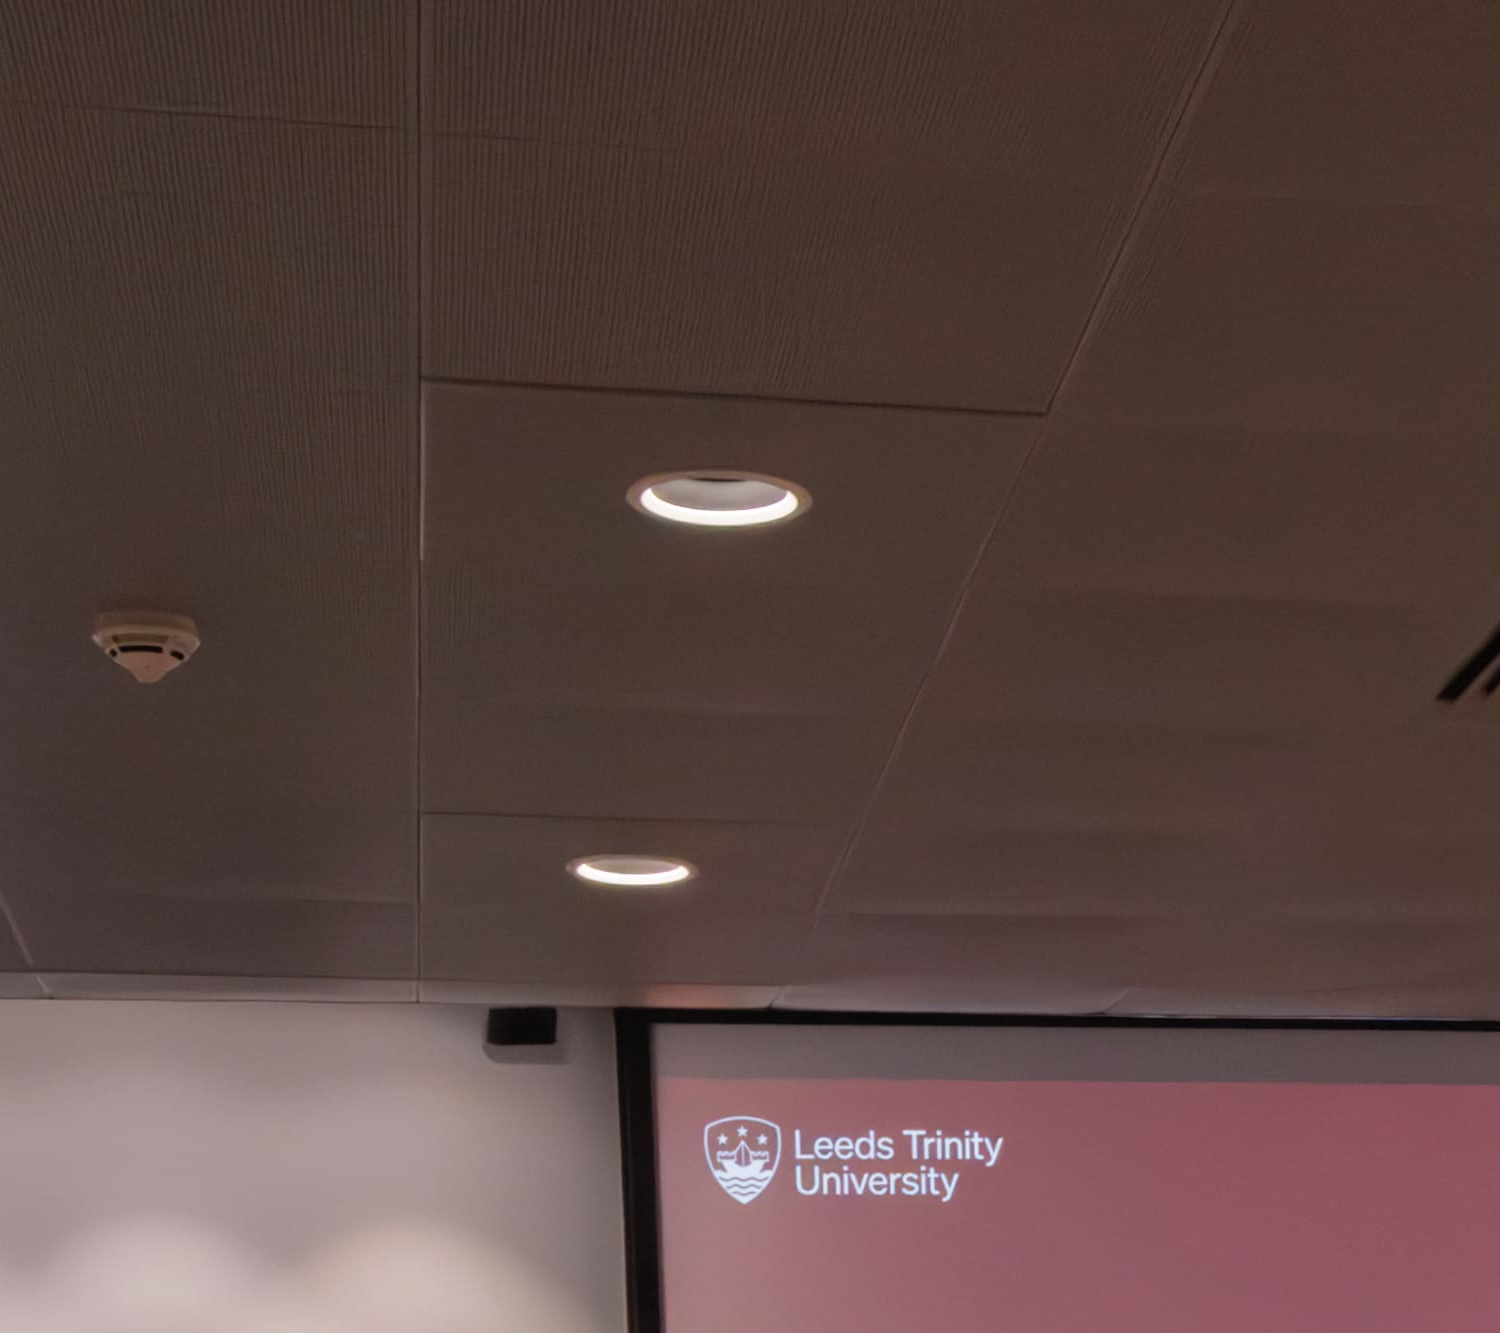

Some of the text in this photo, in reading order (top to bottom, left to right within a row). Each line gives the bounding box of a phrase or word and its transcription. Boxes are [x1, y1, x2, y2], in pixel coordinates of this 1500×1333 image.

[794, 1129, 1004, 1167] Leeds Trinity
[796, 1165, 959, 1202] University
